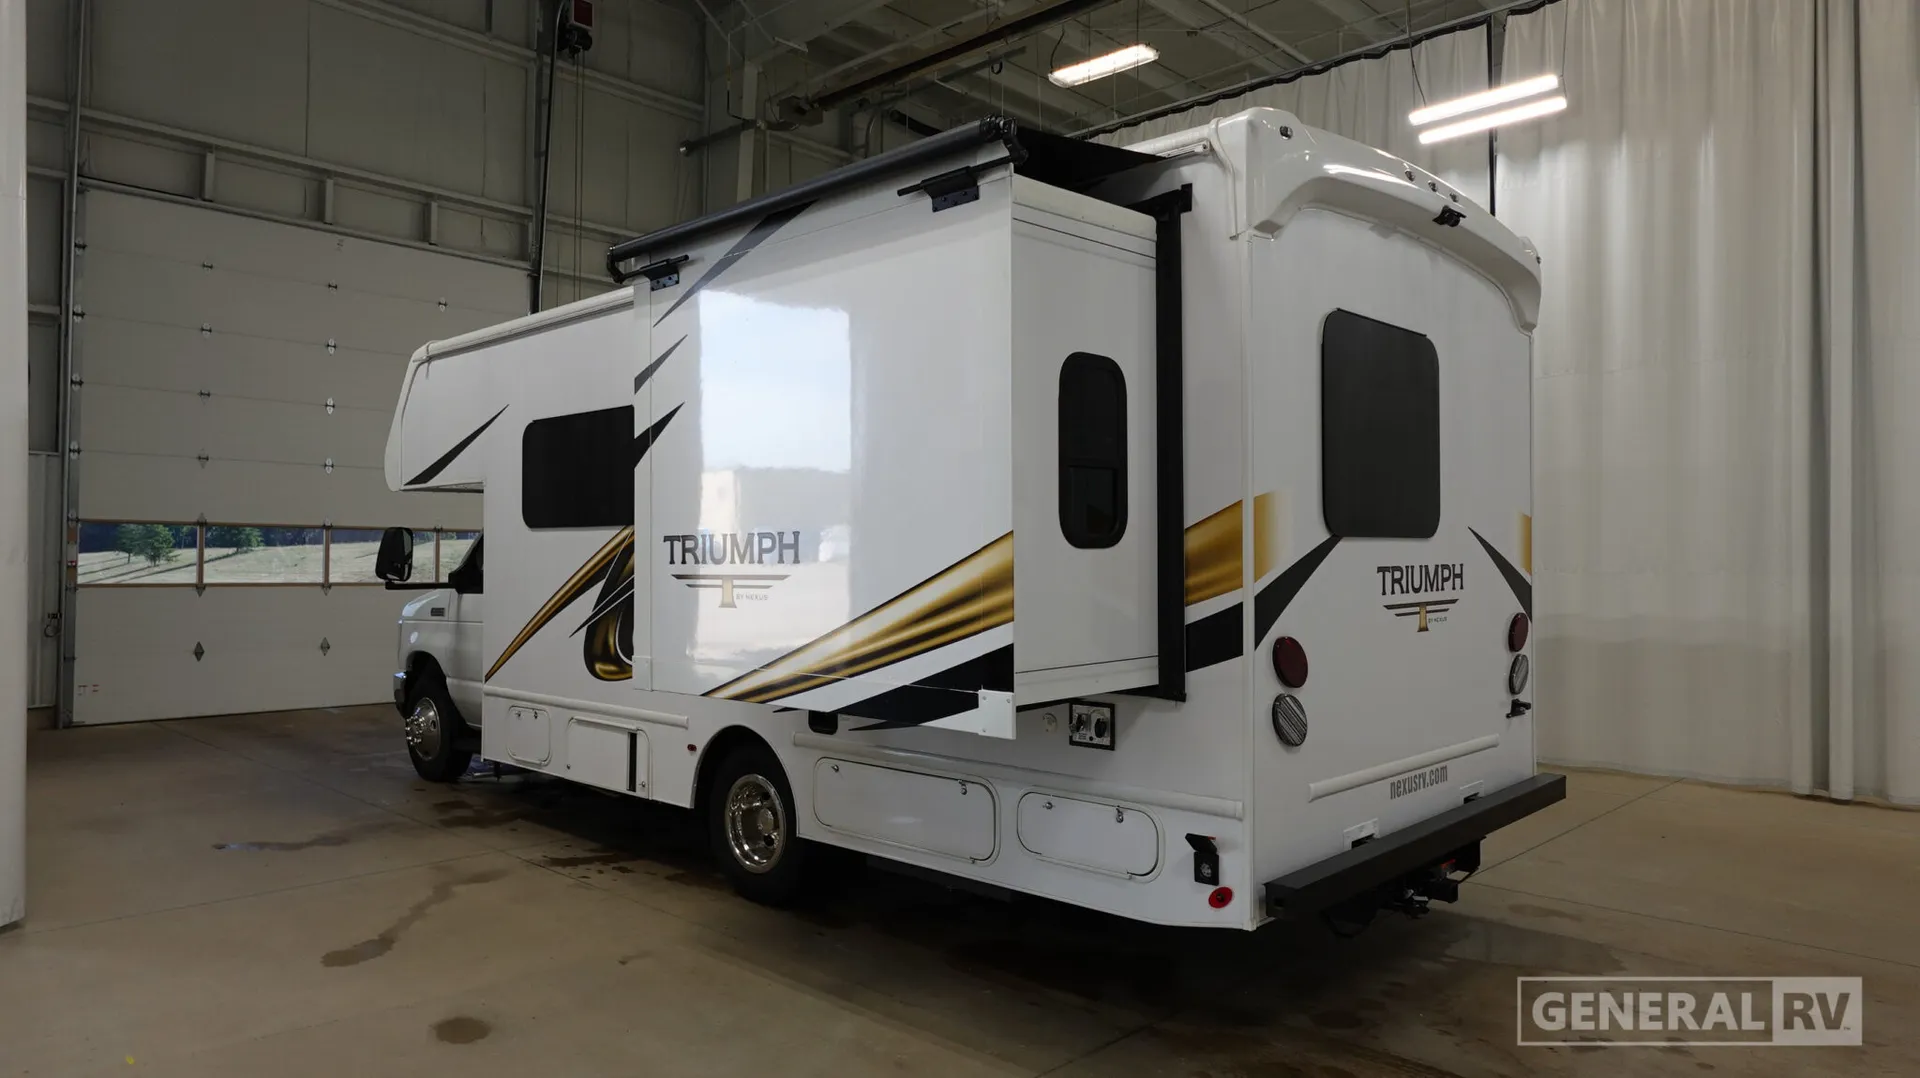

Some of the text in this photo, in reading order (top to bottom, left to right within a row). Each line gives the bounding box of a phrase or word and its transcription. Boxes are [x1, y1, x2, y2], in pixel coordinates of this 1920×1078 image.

[663, 531, 800, 565] TRIUMPH
[1377, 563, 1464, 595] TRIUMPH
[1390, 765, 1448, 800] nexusrv.com
